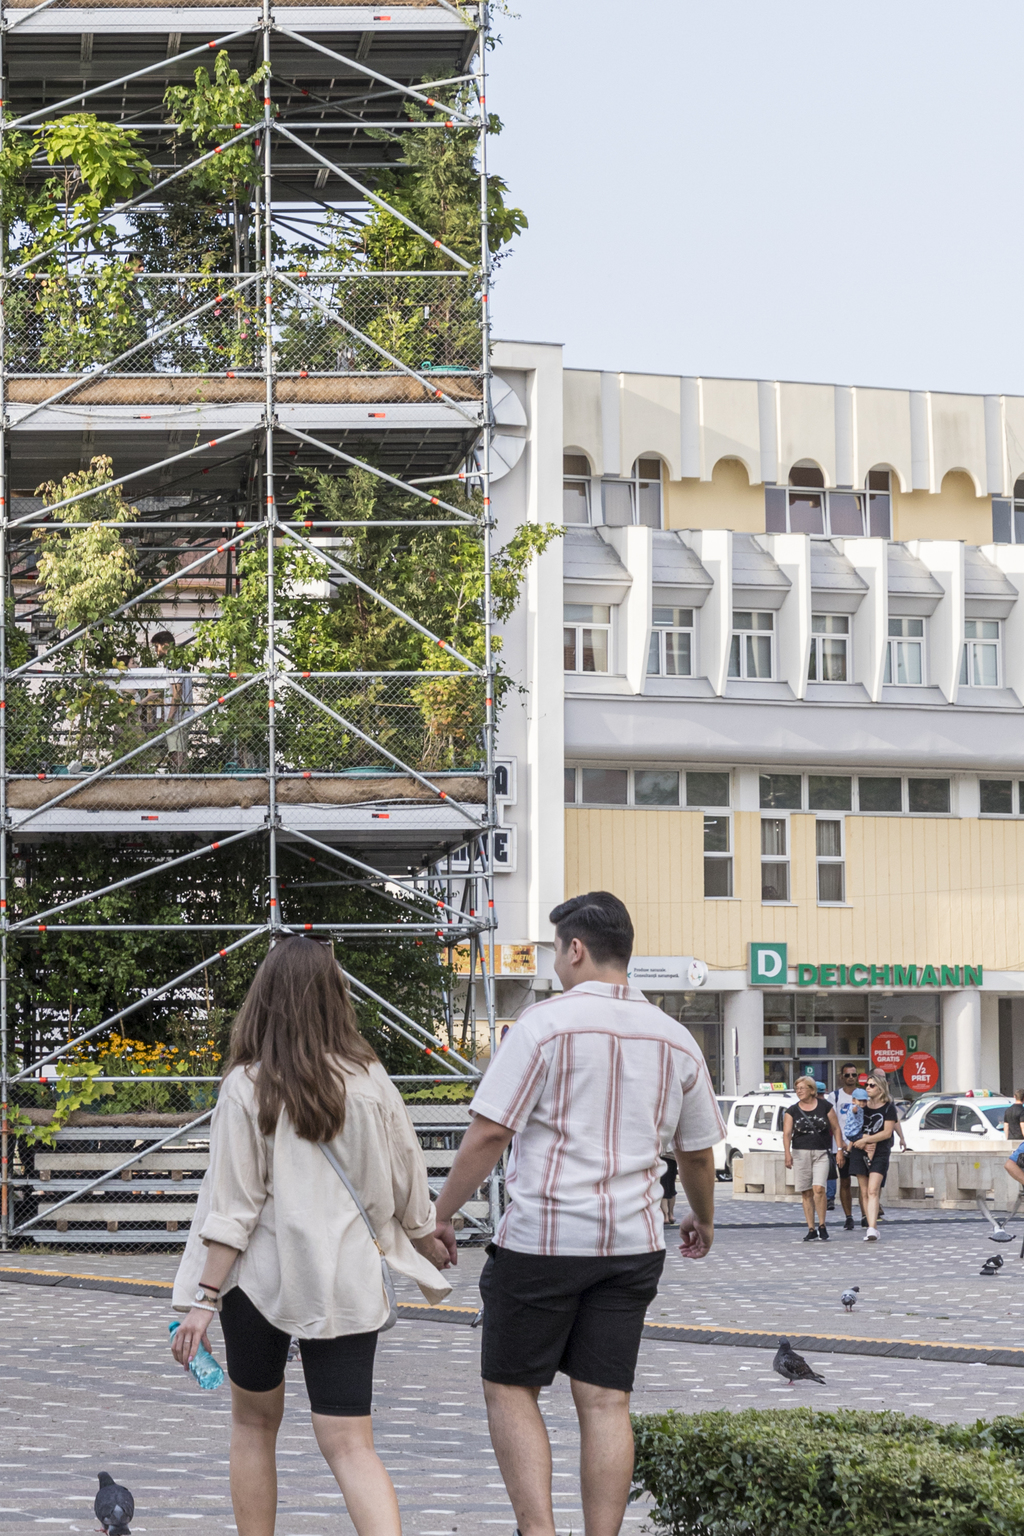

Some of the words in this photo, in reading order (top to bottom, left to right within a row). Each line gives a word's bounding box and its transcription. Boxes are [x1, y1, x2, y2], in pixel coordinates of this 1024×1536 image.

[757, 949, 783, 978] D
[797, 963, 983, 987] DEICHMANN
[885, 1039, 891, 1050] 1
